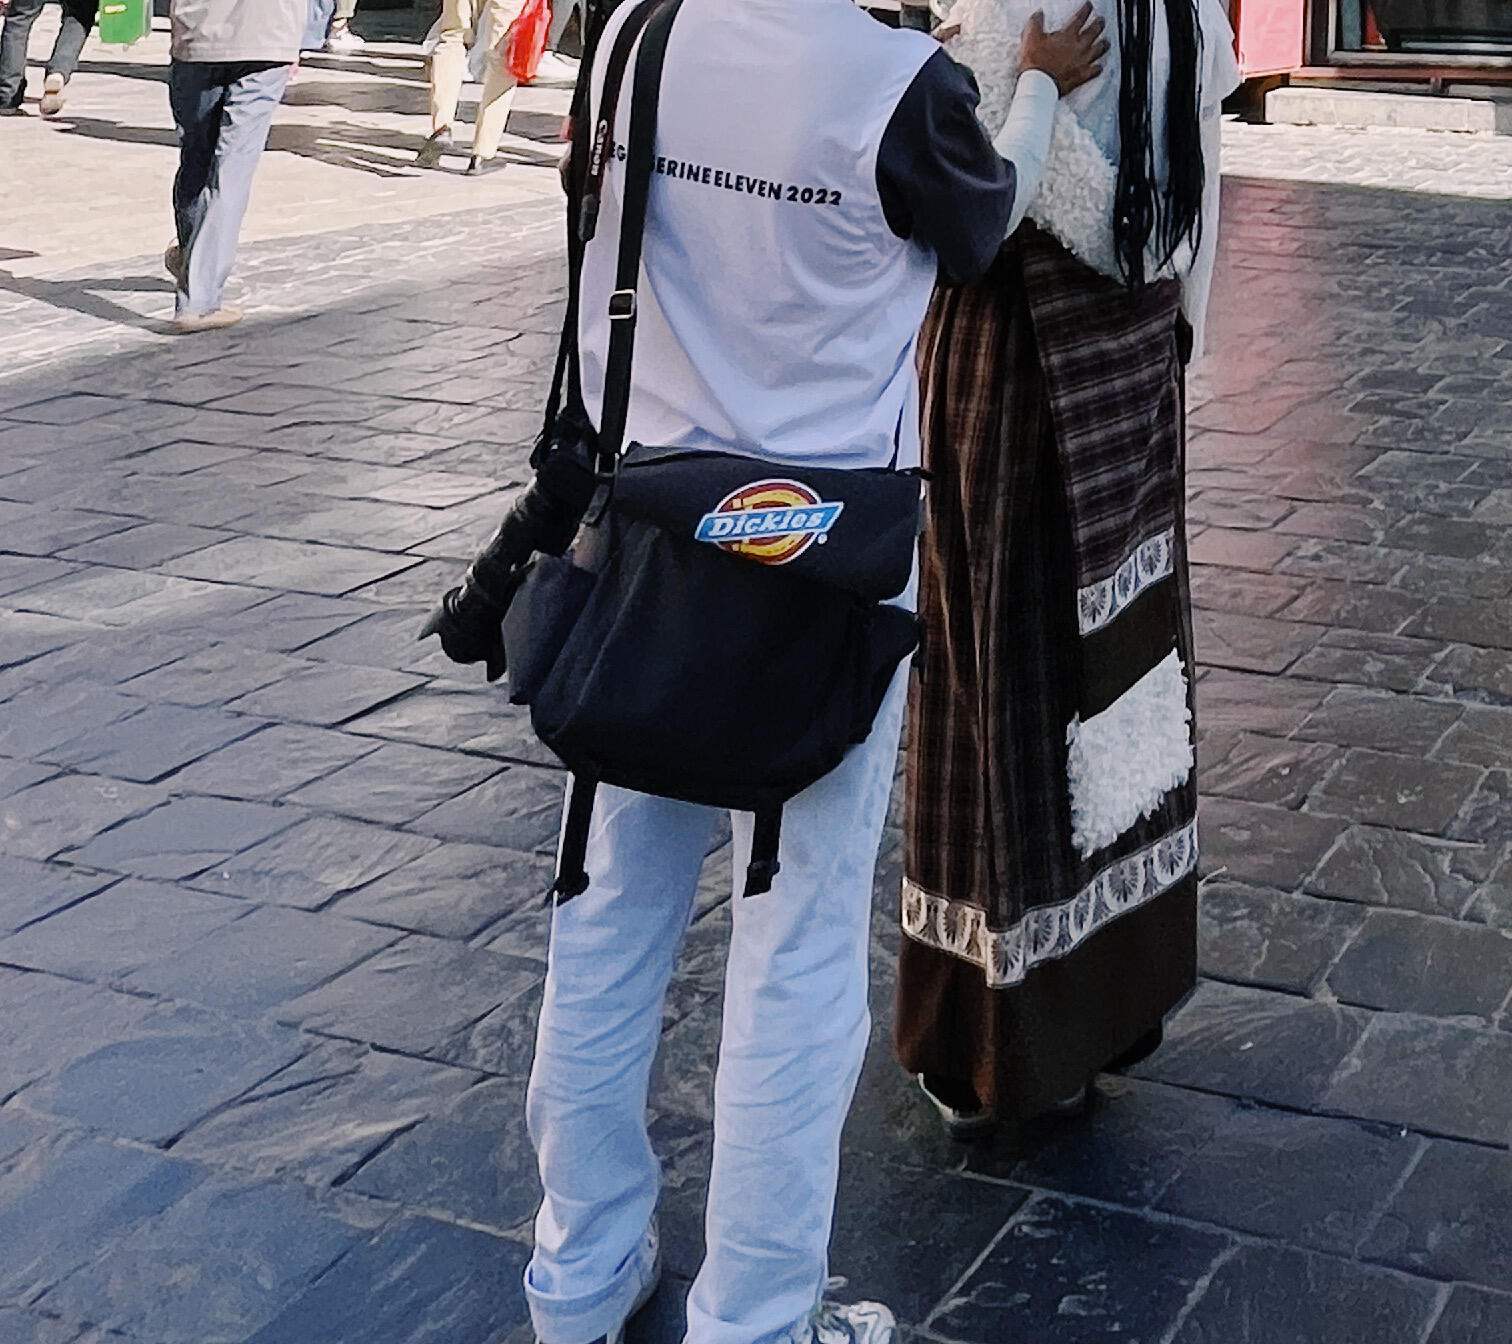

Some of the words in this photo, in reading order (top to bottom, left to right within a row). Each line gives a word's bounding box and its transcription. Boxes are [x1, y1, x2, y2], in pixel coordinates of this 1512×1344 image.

[714, 170, 783, 201] ELEVEN
[786, 185, 842, 206] 2022
[708, 511, 825, 536] Dickies
